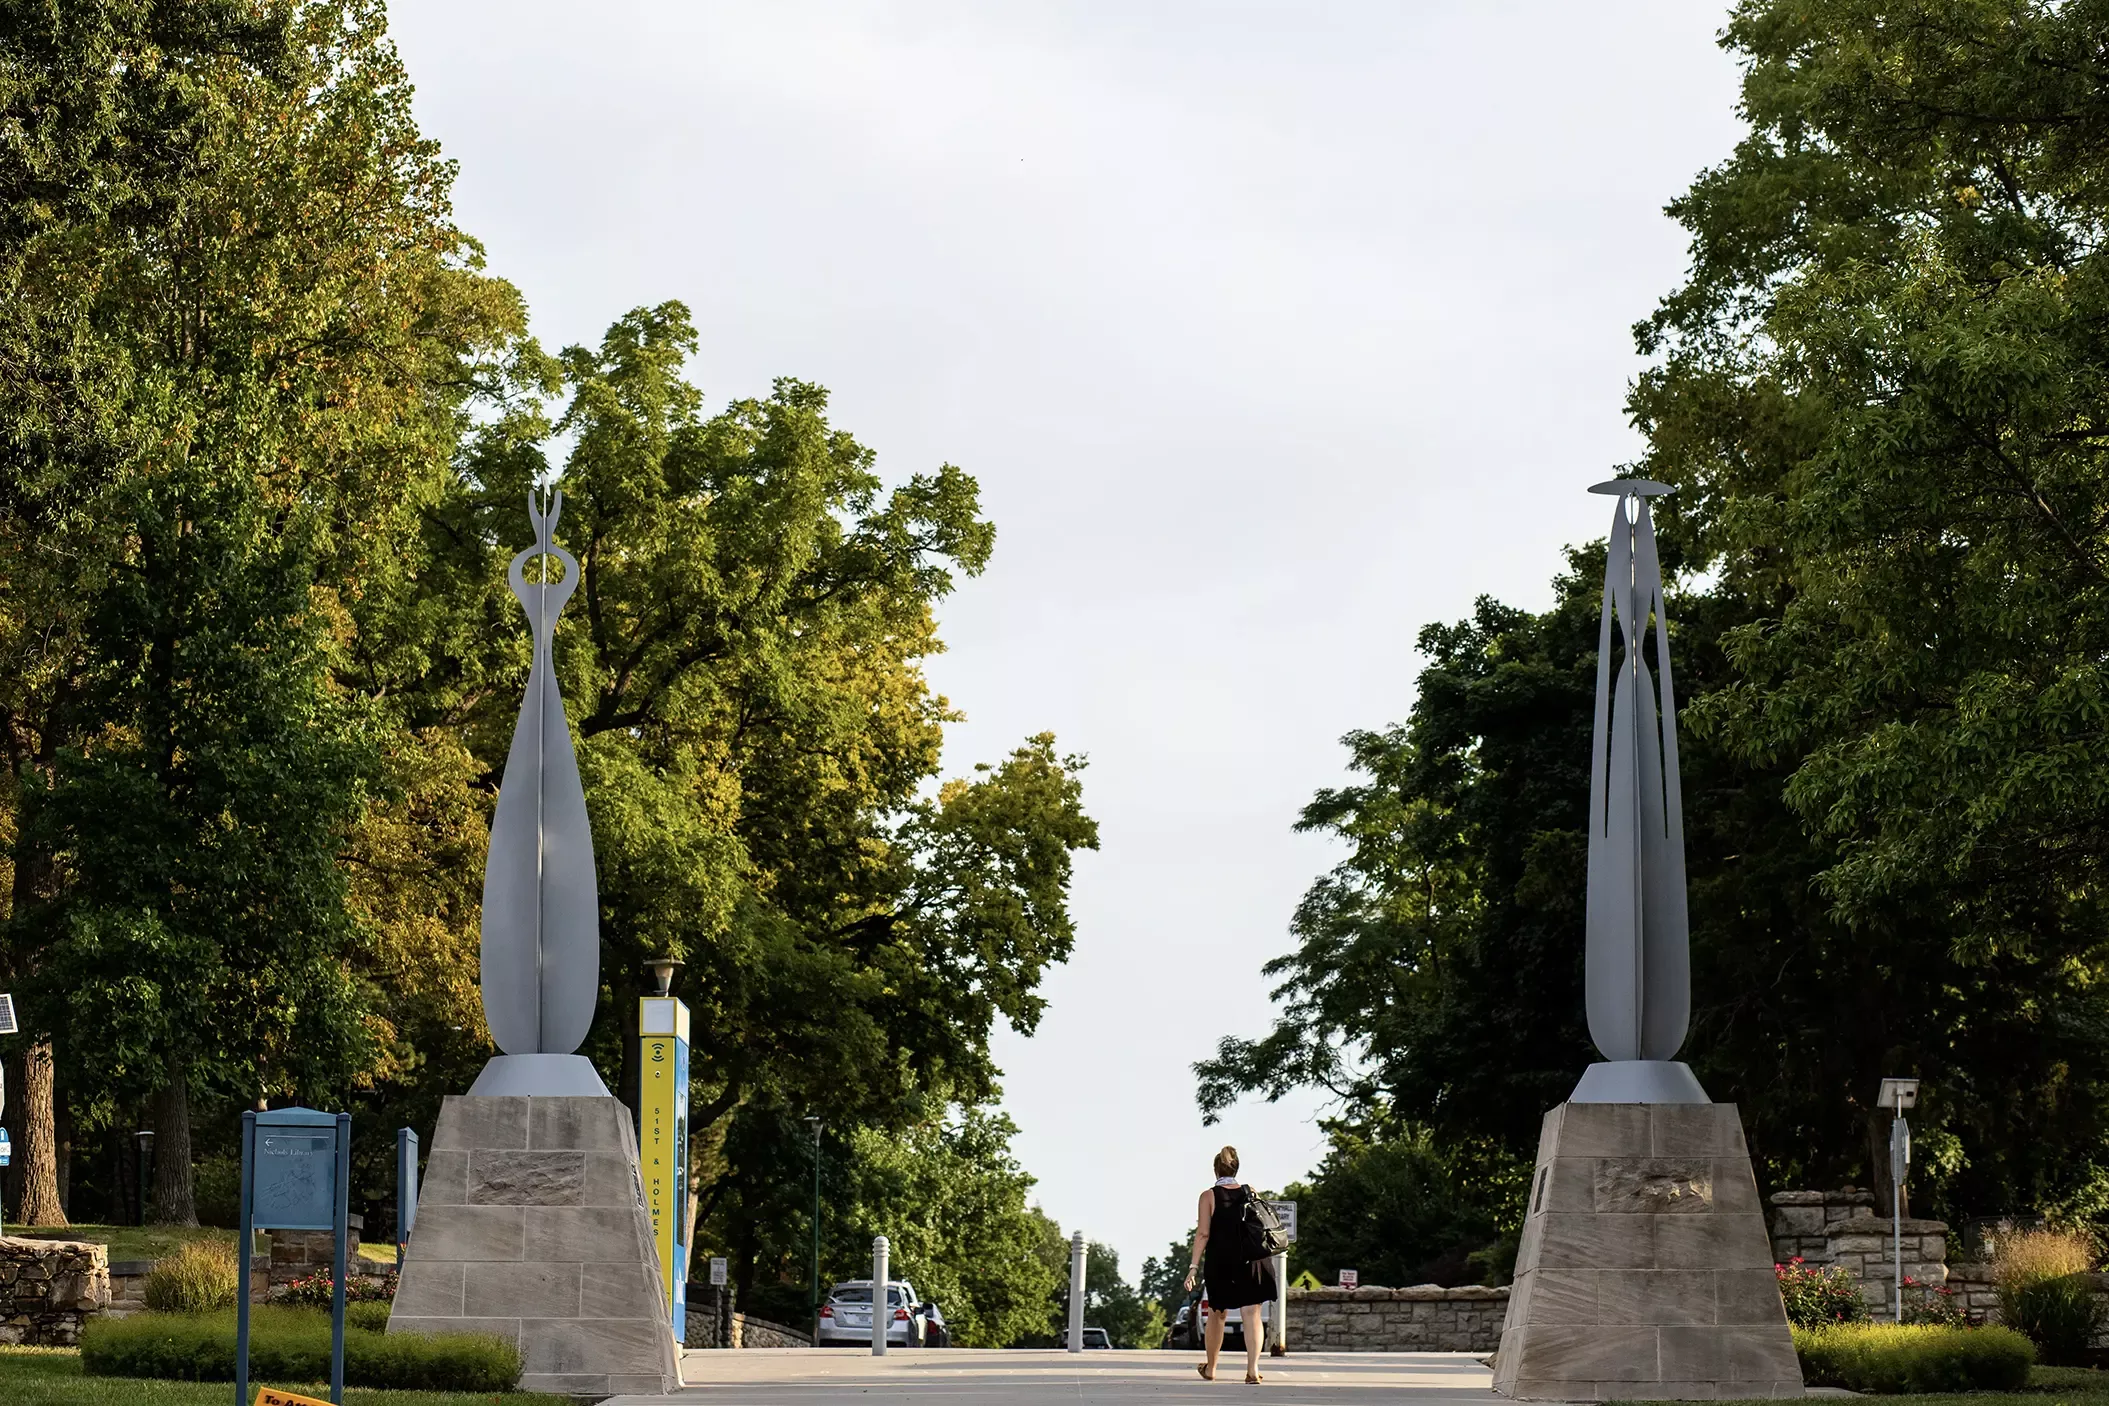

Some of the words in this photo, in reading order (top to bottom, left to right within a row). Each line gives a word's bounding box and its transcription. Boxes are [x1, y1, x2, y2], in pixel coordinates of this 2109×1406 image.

[290, 1148, 313, 1158] Library
[653, 1157, 660, 1165] &
[652, 1178, 660, 1236] HOLMES
[264, 1395, 280, 1405] To
